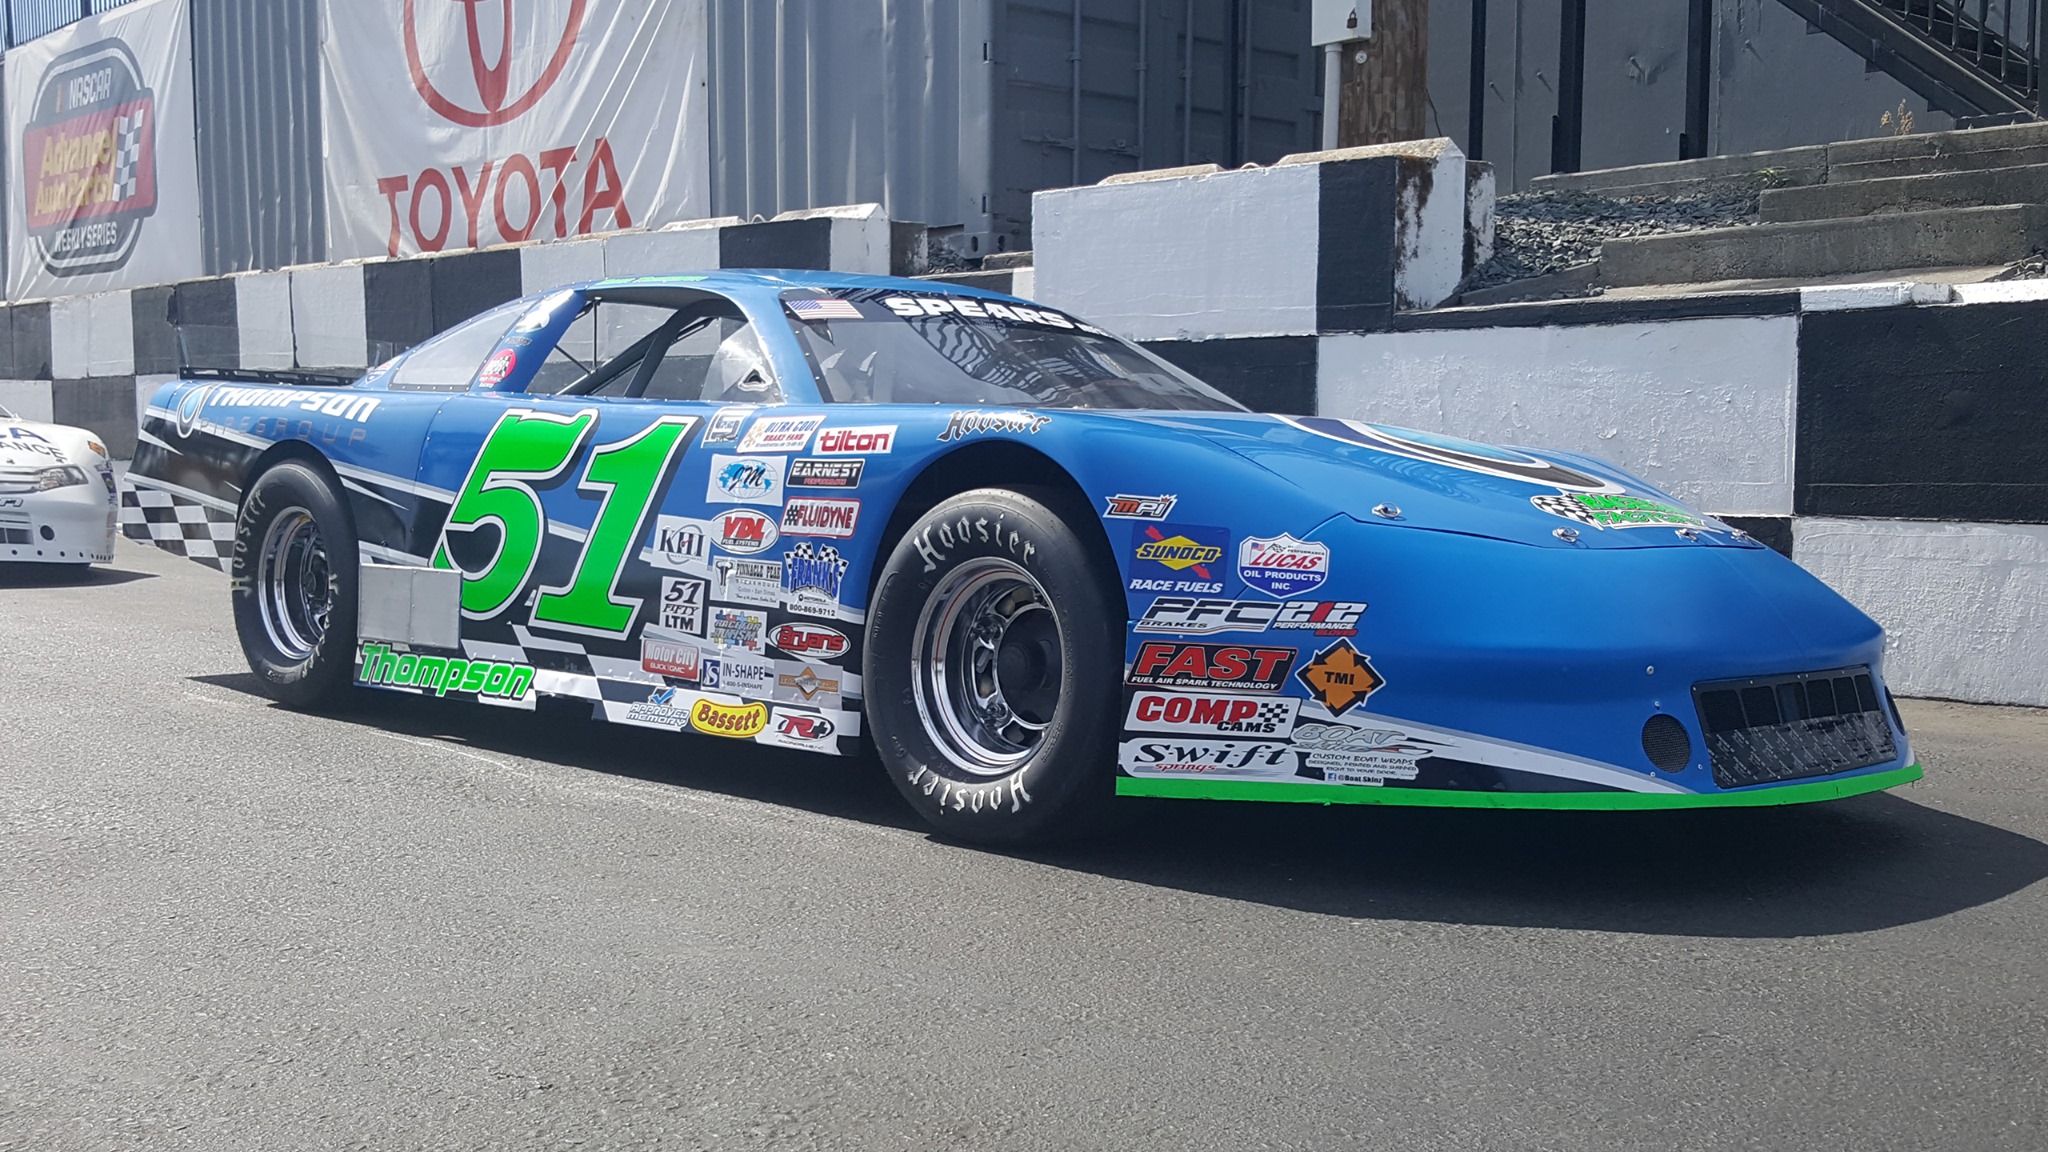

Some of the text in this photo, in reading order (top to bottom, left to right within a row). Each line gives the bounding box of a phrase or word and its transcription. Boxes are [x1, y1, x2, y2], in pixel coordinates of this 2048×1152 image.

[69, 68, 112, 110] NASCAR
[41, 127, 112, 179] Advance
[34, 178, 67, 216] Auto
[377, 136, 632, 258] TOYOTA
[54, 221, 118, 252] WEEKLY SERIES
[884, 297, 1073, 329] SPEARS
[210, 387, 381, 423] THOMPSON
[764, 420, 819, 433] ULTRA COOL
[937, 410, 1054, 442] Hoosier
[820, 430, 889, 452] tilton
[792, 463, 861, 477] EARNEST
[428, 407, 702, 641] 51
[784, 504, 854, 529] #FLUIDYNE
[723, 516, 766, 540] VDL
[721, 538, 760, 548] FUEL SYSTEMS
[912, 513, 1036, 573] Hoosier
[1139, 544, 1219, 561] SUNOCO
[736, 563, 763, 577] PINNACLE
[1250, 552, 1322, 569] LUCAS
[1129, 578, 1224, 594] RACE FUELS
[1243, 570, 1322, 582] OIL PRODUCTS
[1271, 582, 1292, 590] INC.
[664, 580, 702, 604] 51
[662, 603, 700, 616] FIFTY
[790, 604, 836, 616] 800-869-9712
[1144, 598, 1281, 625] PFC
[1276, 601, 1368, 622] 212
[665, 615, 694, 631] LTM
[714, 620, 739, 630] RACE
[1272, 621, 1356, 630] PERFORMANCE
[777, 626, 845, 652] Bryans
[645, 642, 697, 670] Motor City
[1135, 644, 1290, 681] FAST
[359, 642, 536, 698] Thompson
[650, 662, 686, 674] BUICK GMC
[722, 662, 764, 680] IN-SHAPE
[1324, 671, 1355, 685] TMI
[1131, 676, 1278, 690] FUEL AIR SPARK TECHNOLOGY
[627, 712, 686, 726] MEMORY
[631, 703, 690, 718] APPROVED
[697, 704, 760, 731] Bassett
[1136, 696, 1258, 724] COMP
[1217, 721, 1277, 733] CAMS
[1293, 724, 1406, 745] BOAT
[1155, 761, 1217, 772] springs
[1313, 753, 1351, 761] CUSTOM
[1354, 755, 1379, 763] BOAT
[908, 763, 1033, 815] Hoosier
